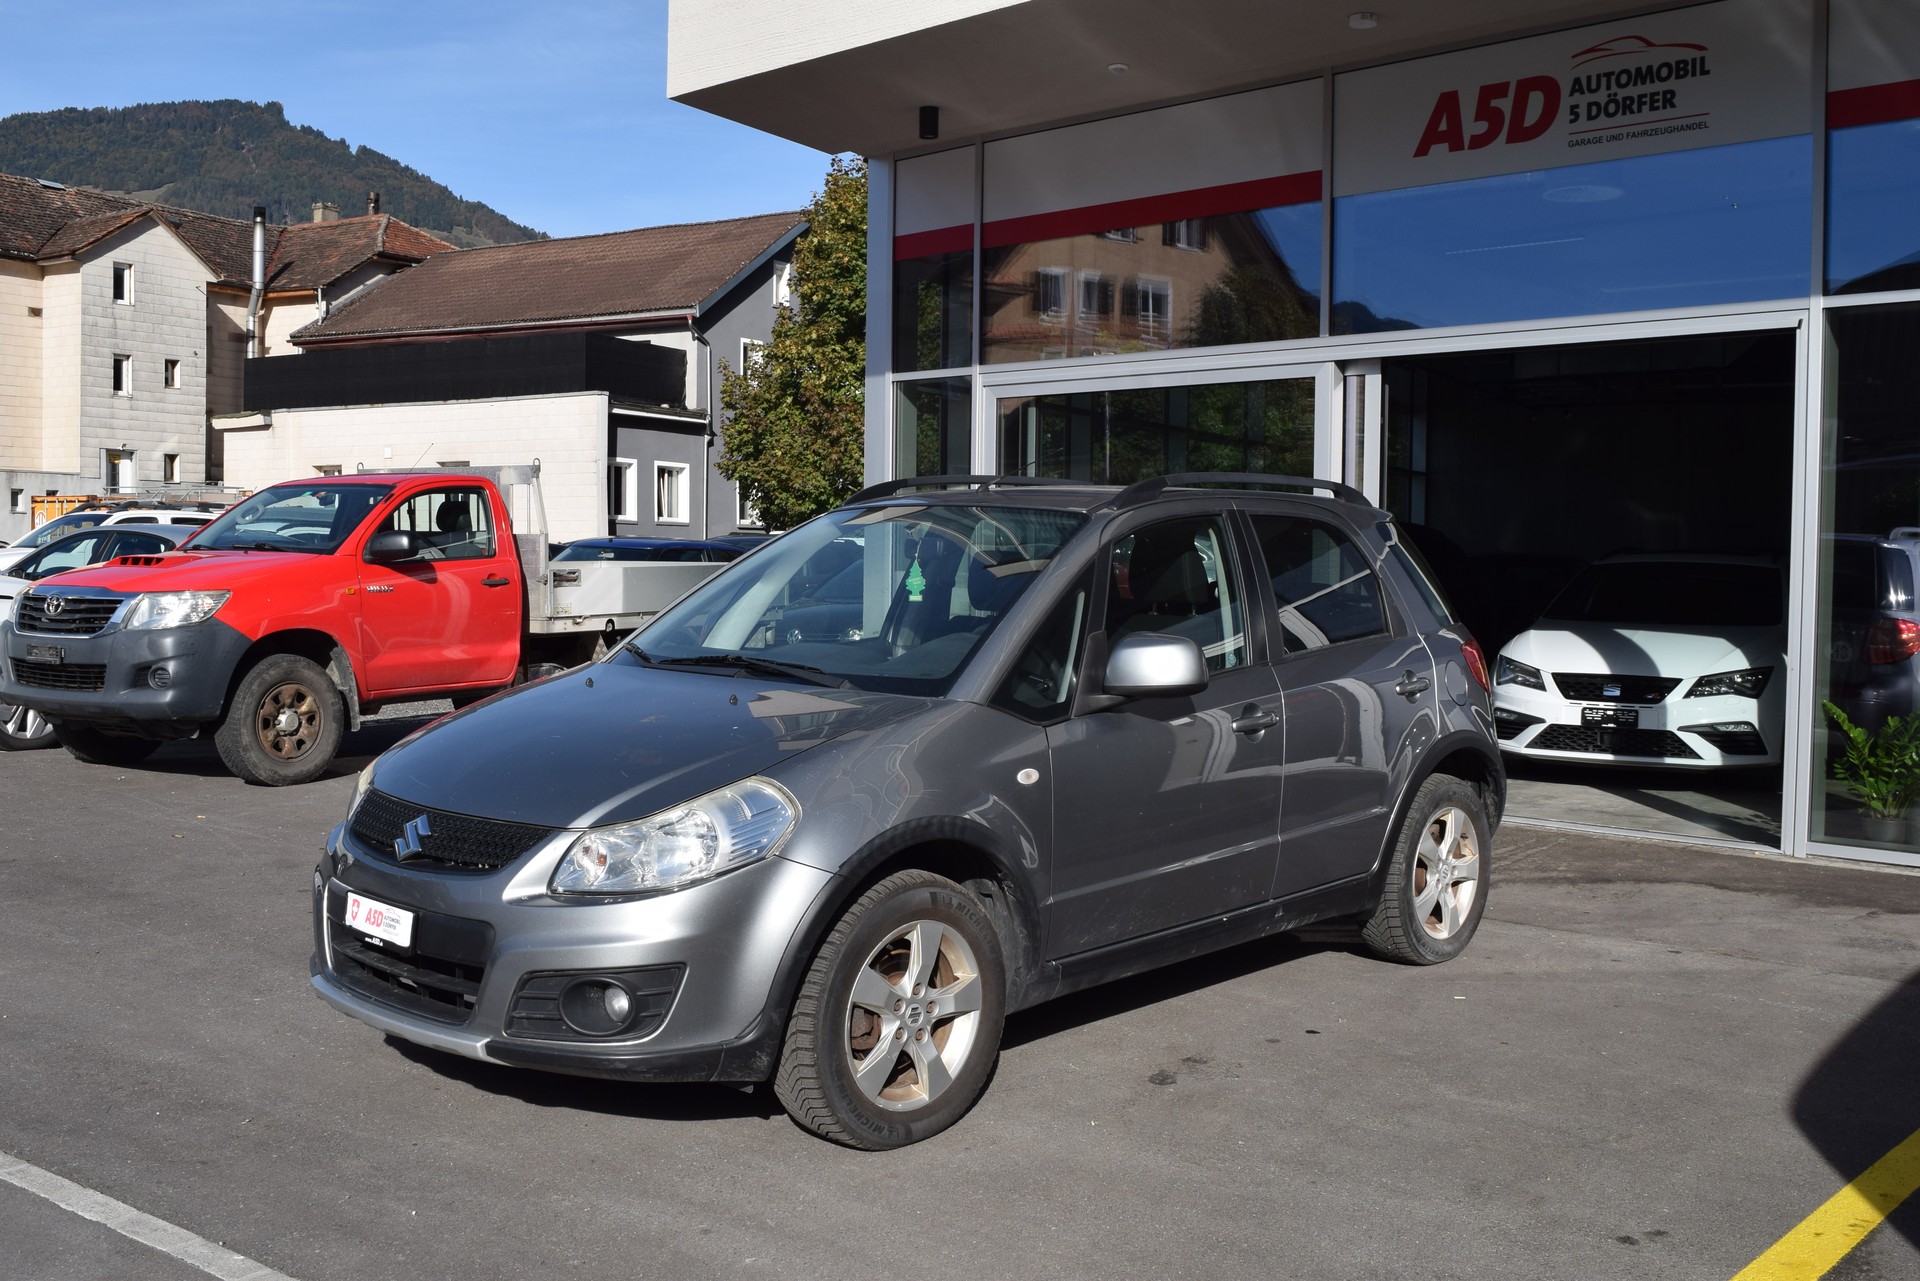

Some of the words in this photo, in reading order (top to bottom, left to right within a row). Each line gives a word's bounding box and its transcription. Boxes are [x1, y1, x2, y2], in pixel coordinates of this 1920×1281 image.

[1568, 56, 1711, 98] AUTOMOBIL
[1413, 75, 1562, 158] A5D
[1569, 104, 1580, 124] 5
[1586, 89, 1677, 121] DÖRFER
[1568, 136, 1603, 148] GARAGE
[1606, 133, 1624, 142] UND
[1626, 121, 1709, 139] FAHRZEUGHANDEL
[365, 907, 383, 928] A5D
